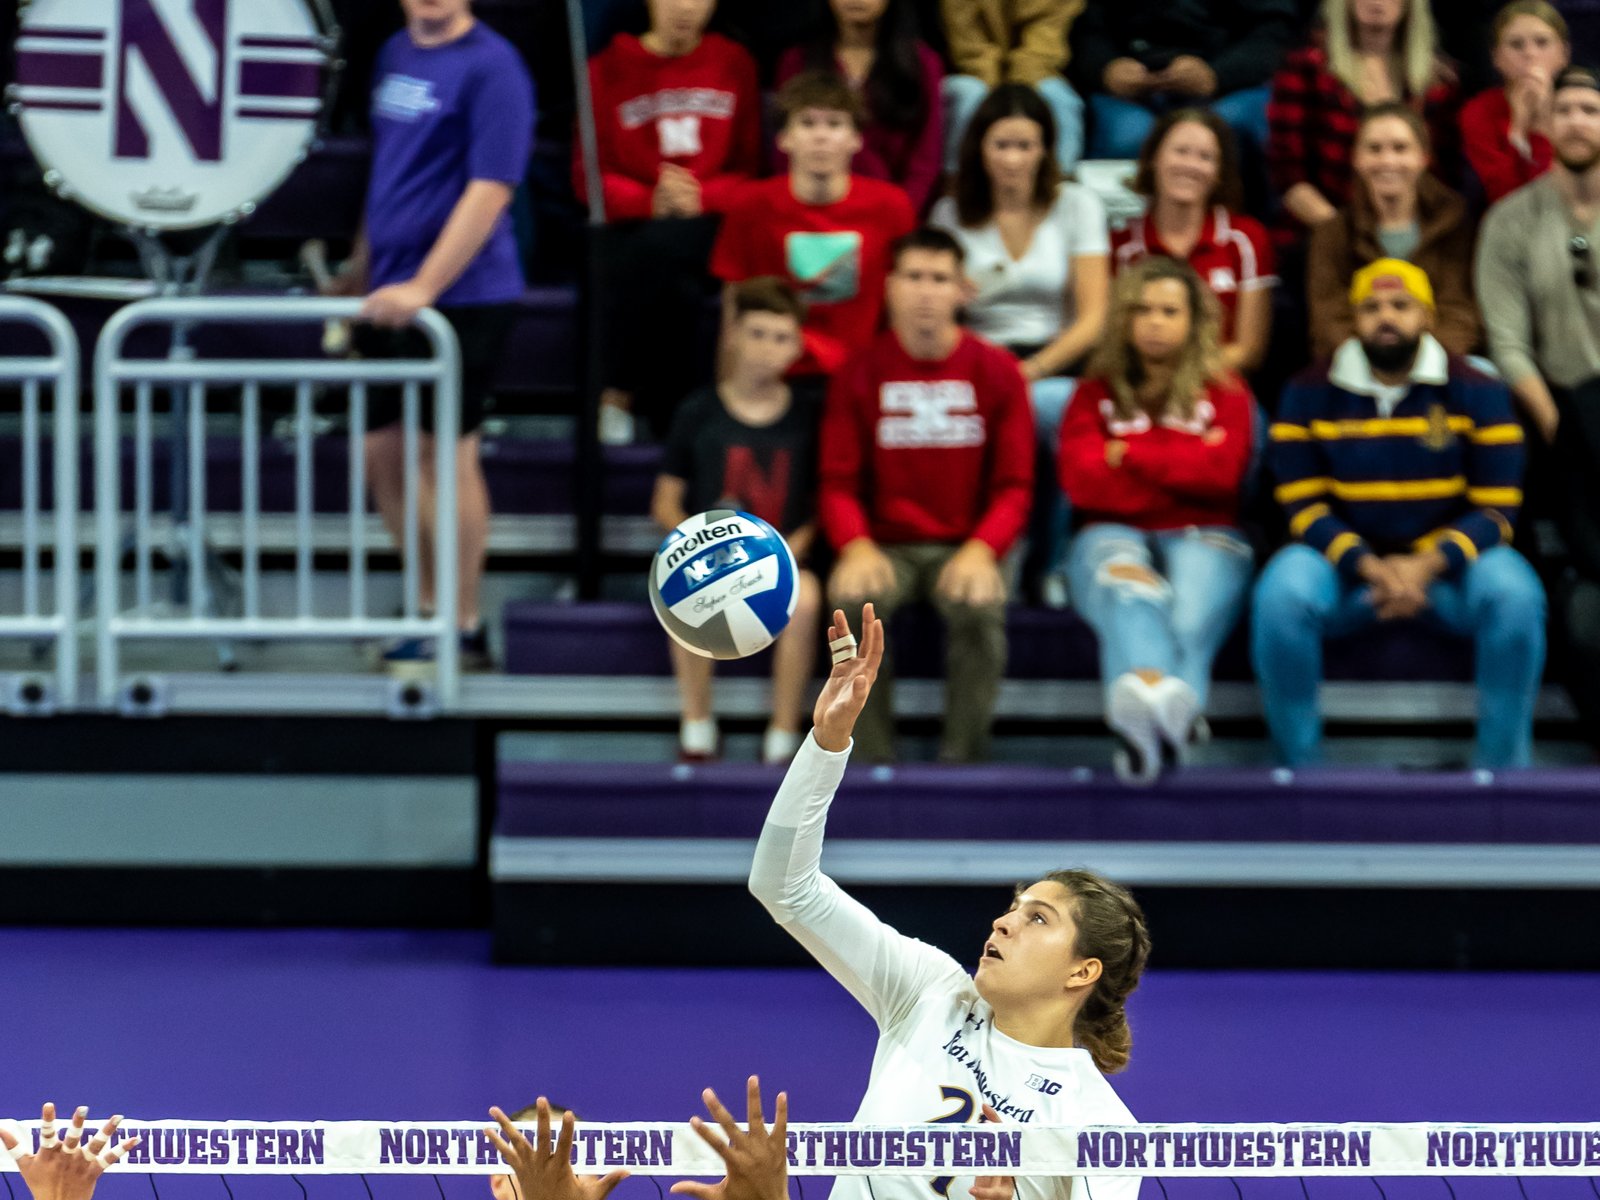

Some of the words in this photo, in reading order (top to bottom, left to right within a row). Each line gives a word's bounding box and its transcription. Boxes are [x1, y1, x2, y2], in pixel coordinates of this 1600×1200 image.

[113, 0, 227, 162] N
[667, 523, 742, 569] molten
[683, 541, 750, 591] NCAA
[31, 1128, 324, 1164] THWESTERN
[1077, 1131, 1371, 1168] NORTHWESTERN
[1426, 1131, 1600, 1168] NORTHWE
